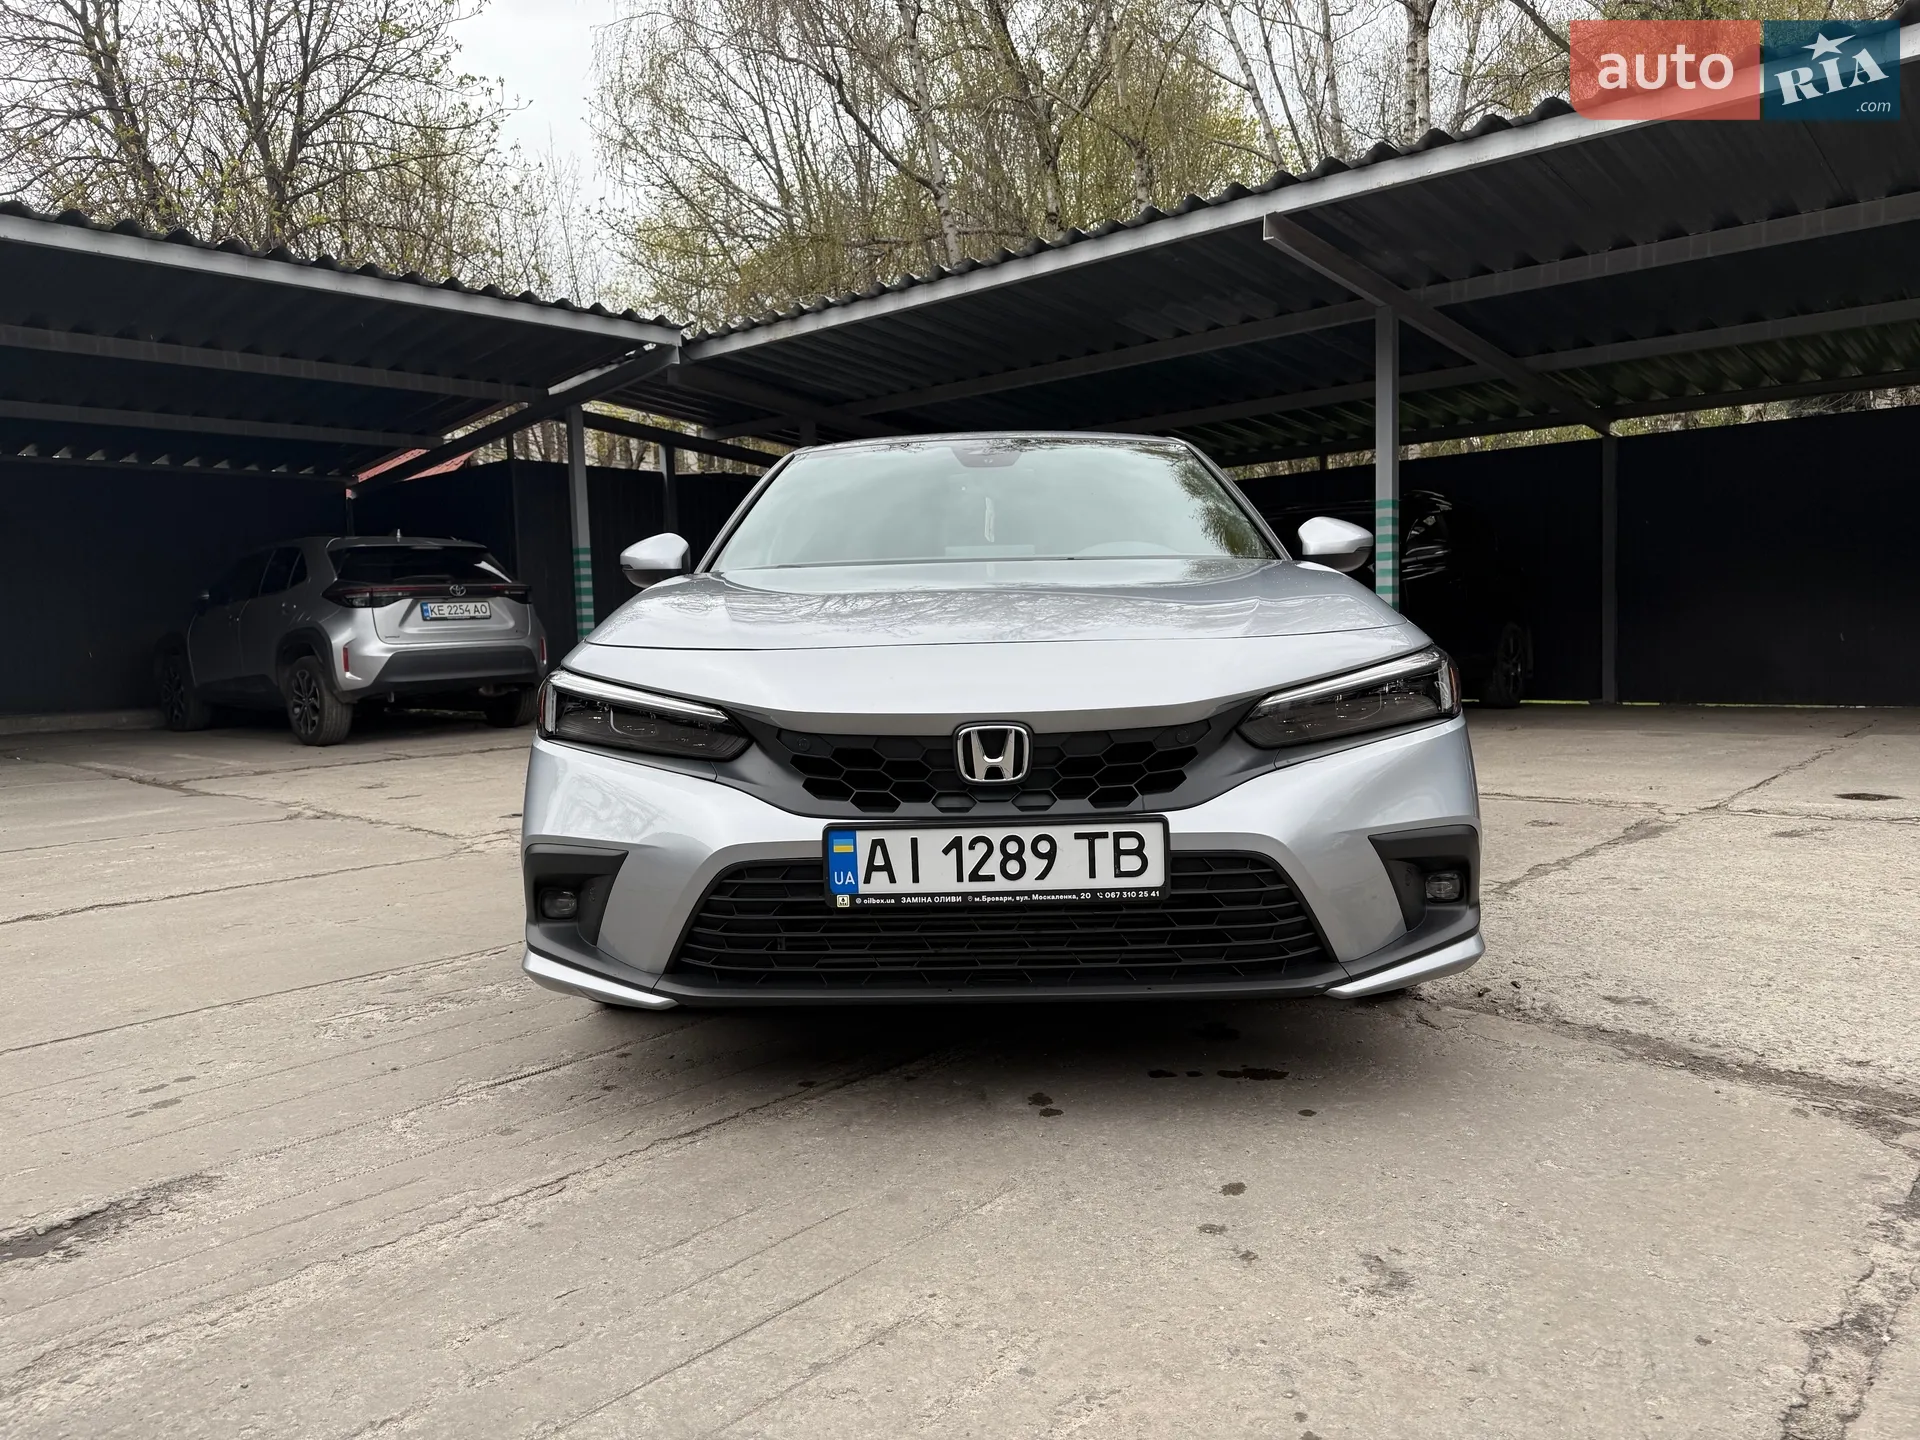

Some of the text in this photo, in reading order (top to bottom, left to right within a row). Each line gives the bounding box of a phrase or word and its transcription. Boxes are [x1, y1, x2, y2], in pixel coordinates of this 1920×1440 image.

[430, 603, 488, 615] KE 2254 AO
[862, 831, 1149, 885] AI 1289 TB
[834, 870, 856, 885] UA
[933, 895, 962, 903] ОЛИВИ
[1122, 891, 1137, 899] 310
